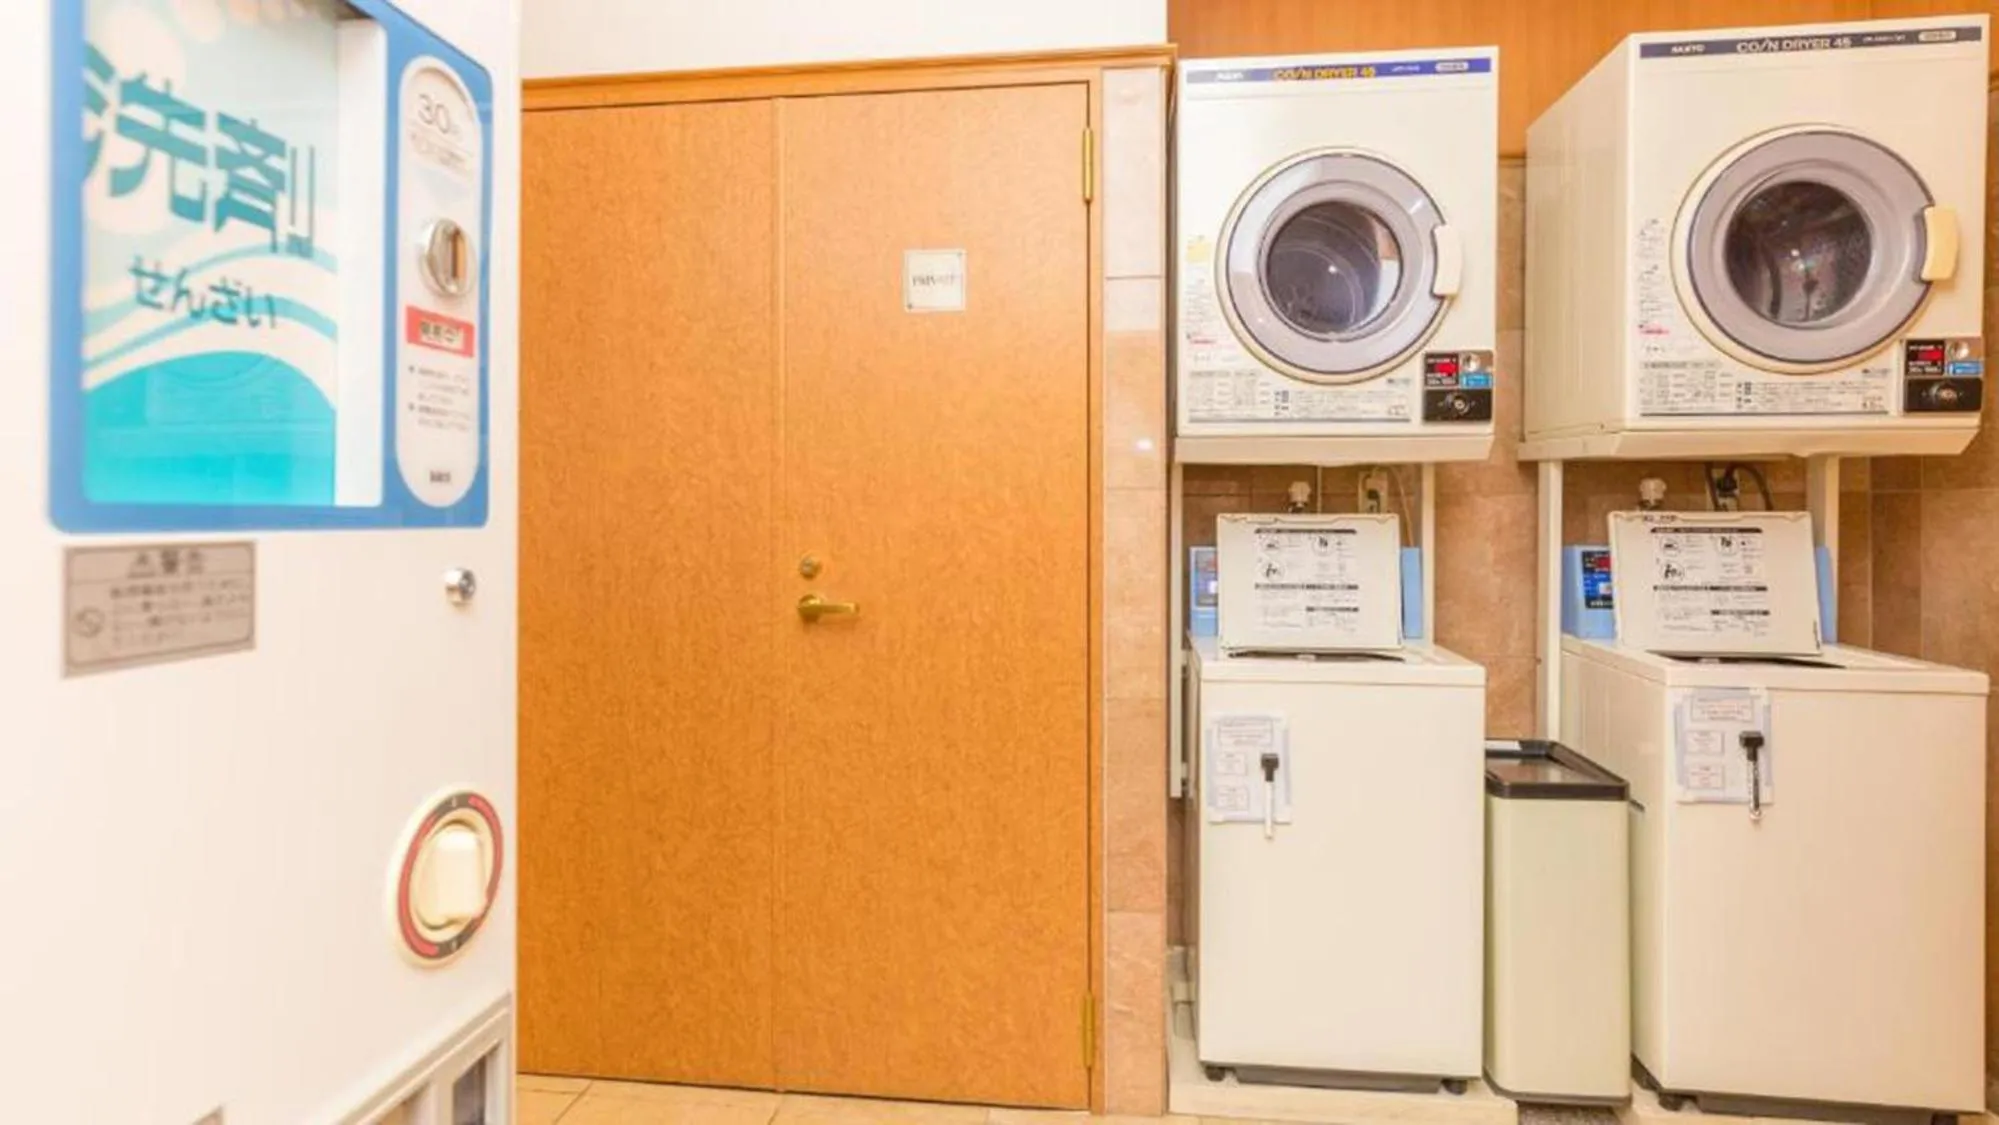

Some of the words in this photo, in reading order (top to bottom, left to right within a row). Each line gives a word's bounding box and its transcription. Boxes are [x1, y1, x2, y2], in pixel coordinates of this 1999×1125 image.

[1782, 38, 1830, 52] DRYER
[911, 274, 957, 287] PRIV
[128, 254, 278, 330] せんざい
